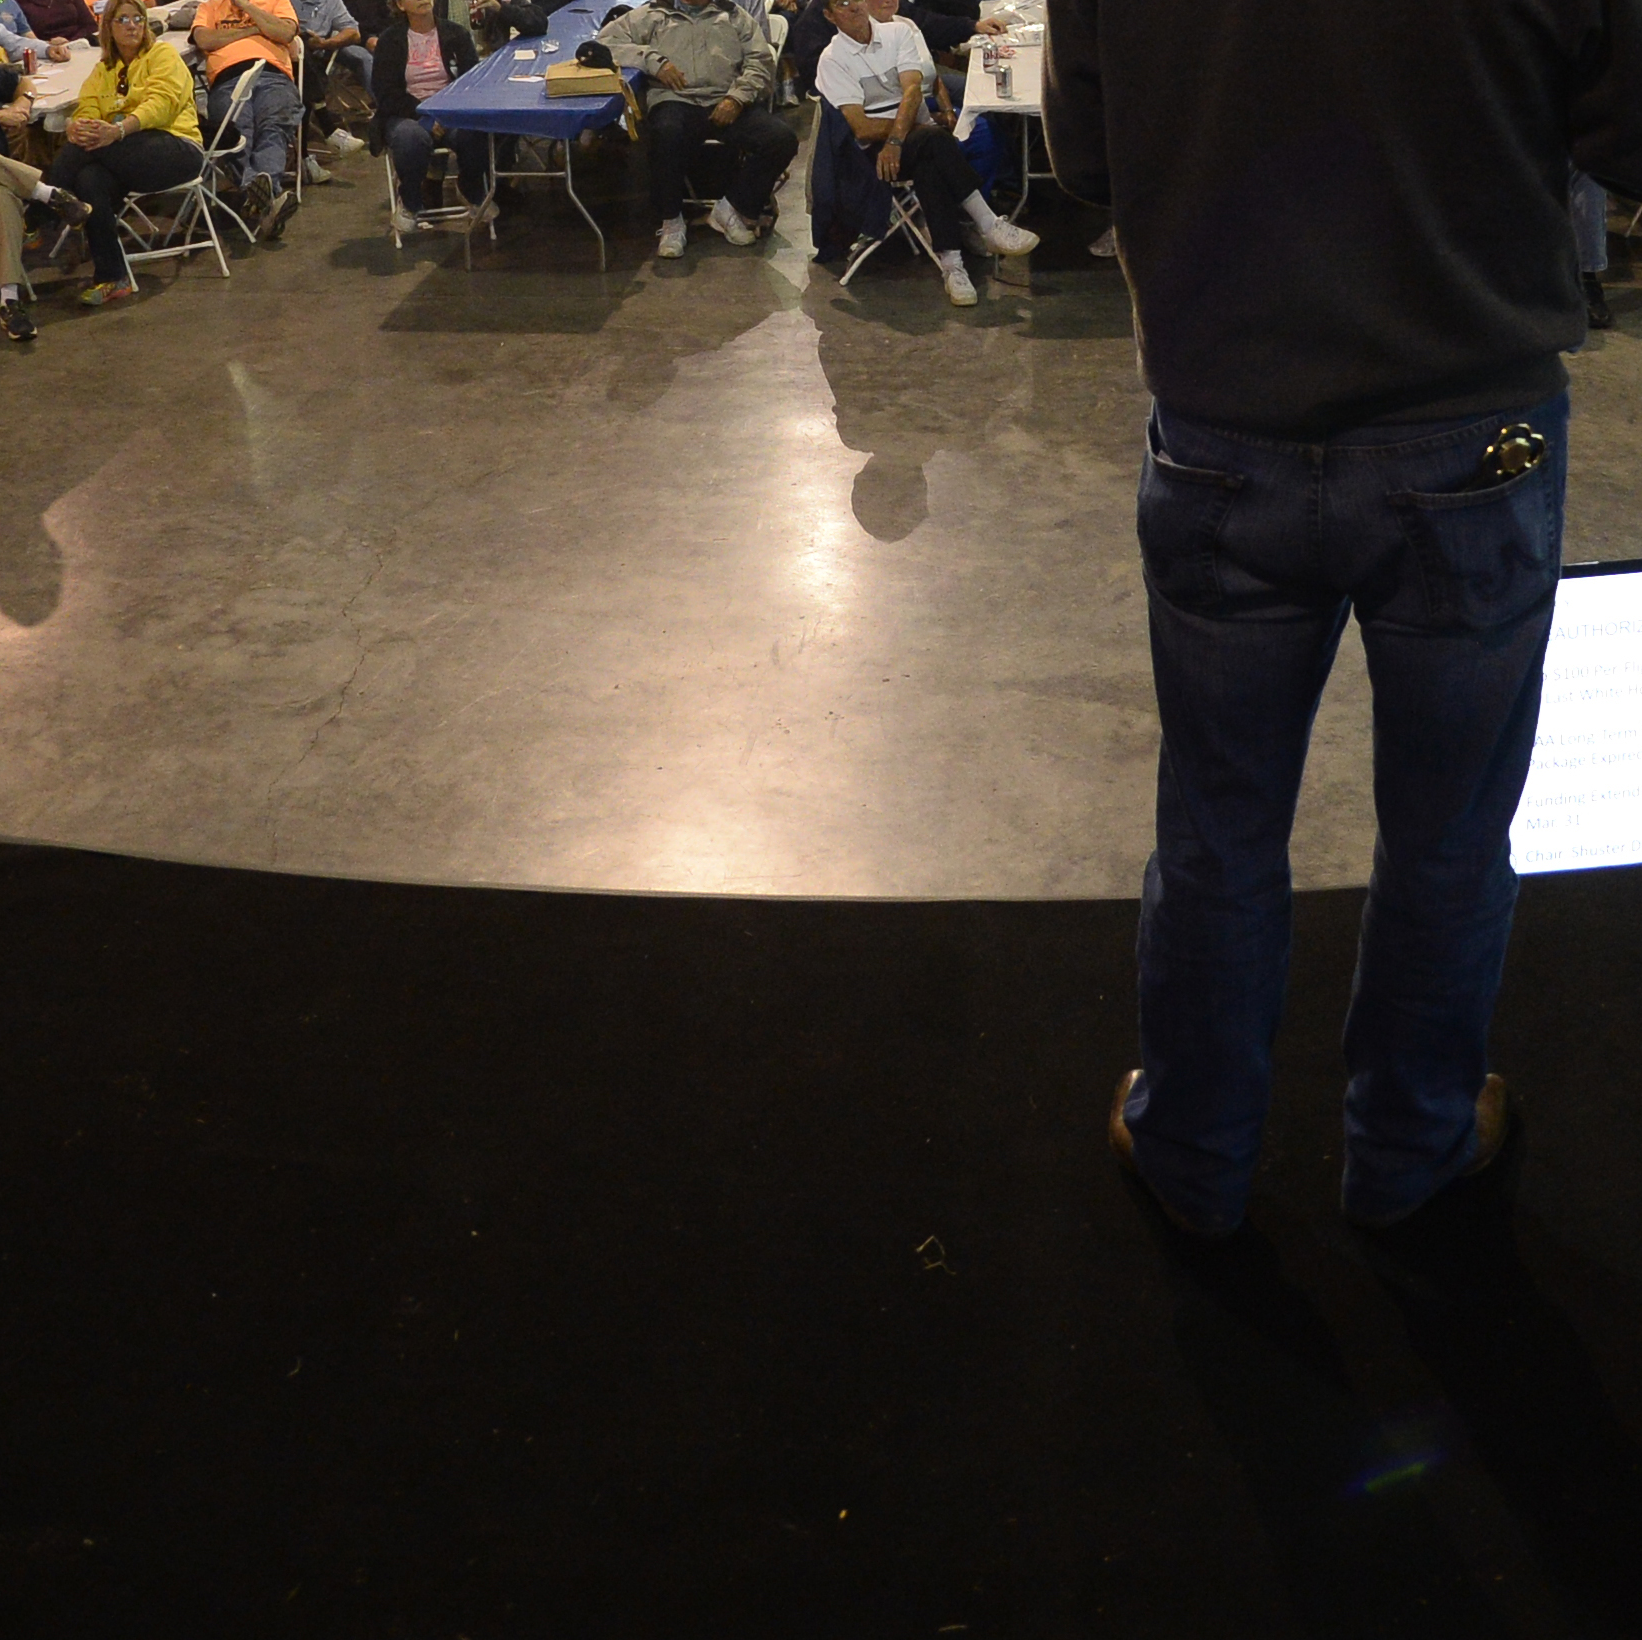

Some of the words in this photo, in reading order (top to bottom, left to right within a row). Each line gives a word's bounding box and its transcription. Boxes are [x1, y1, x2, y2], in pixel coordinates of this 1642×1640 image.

[1553, 665, 1589, 681] $100
[1579, 688, 1623, 701] White
[1526, 792, 1586, 809] Funding
[1565, 813, 1580, 827] 31
[1571, 841, 1626, 858] Shuster
